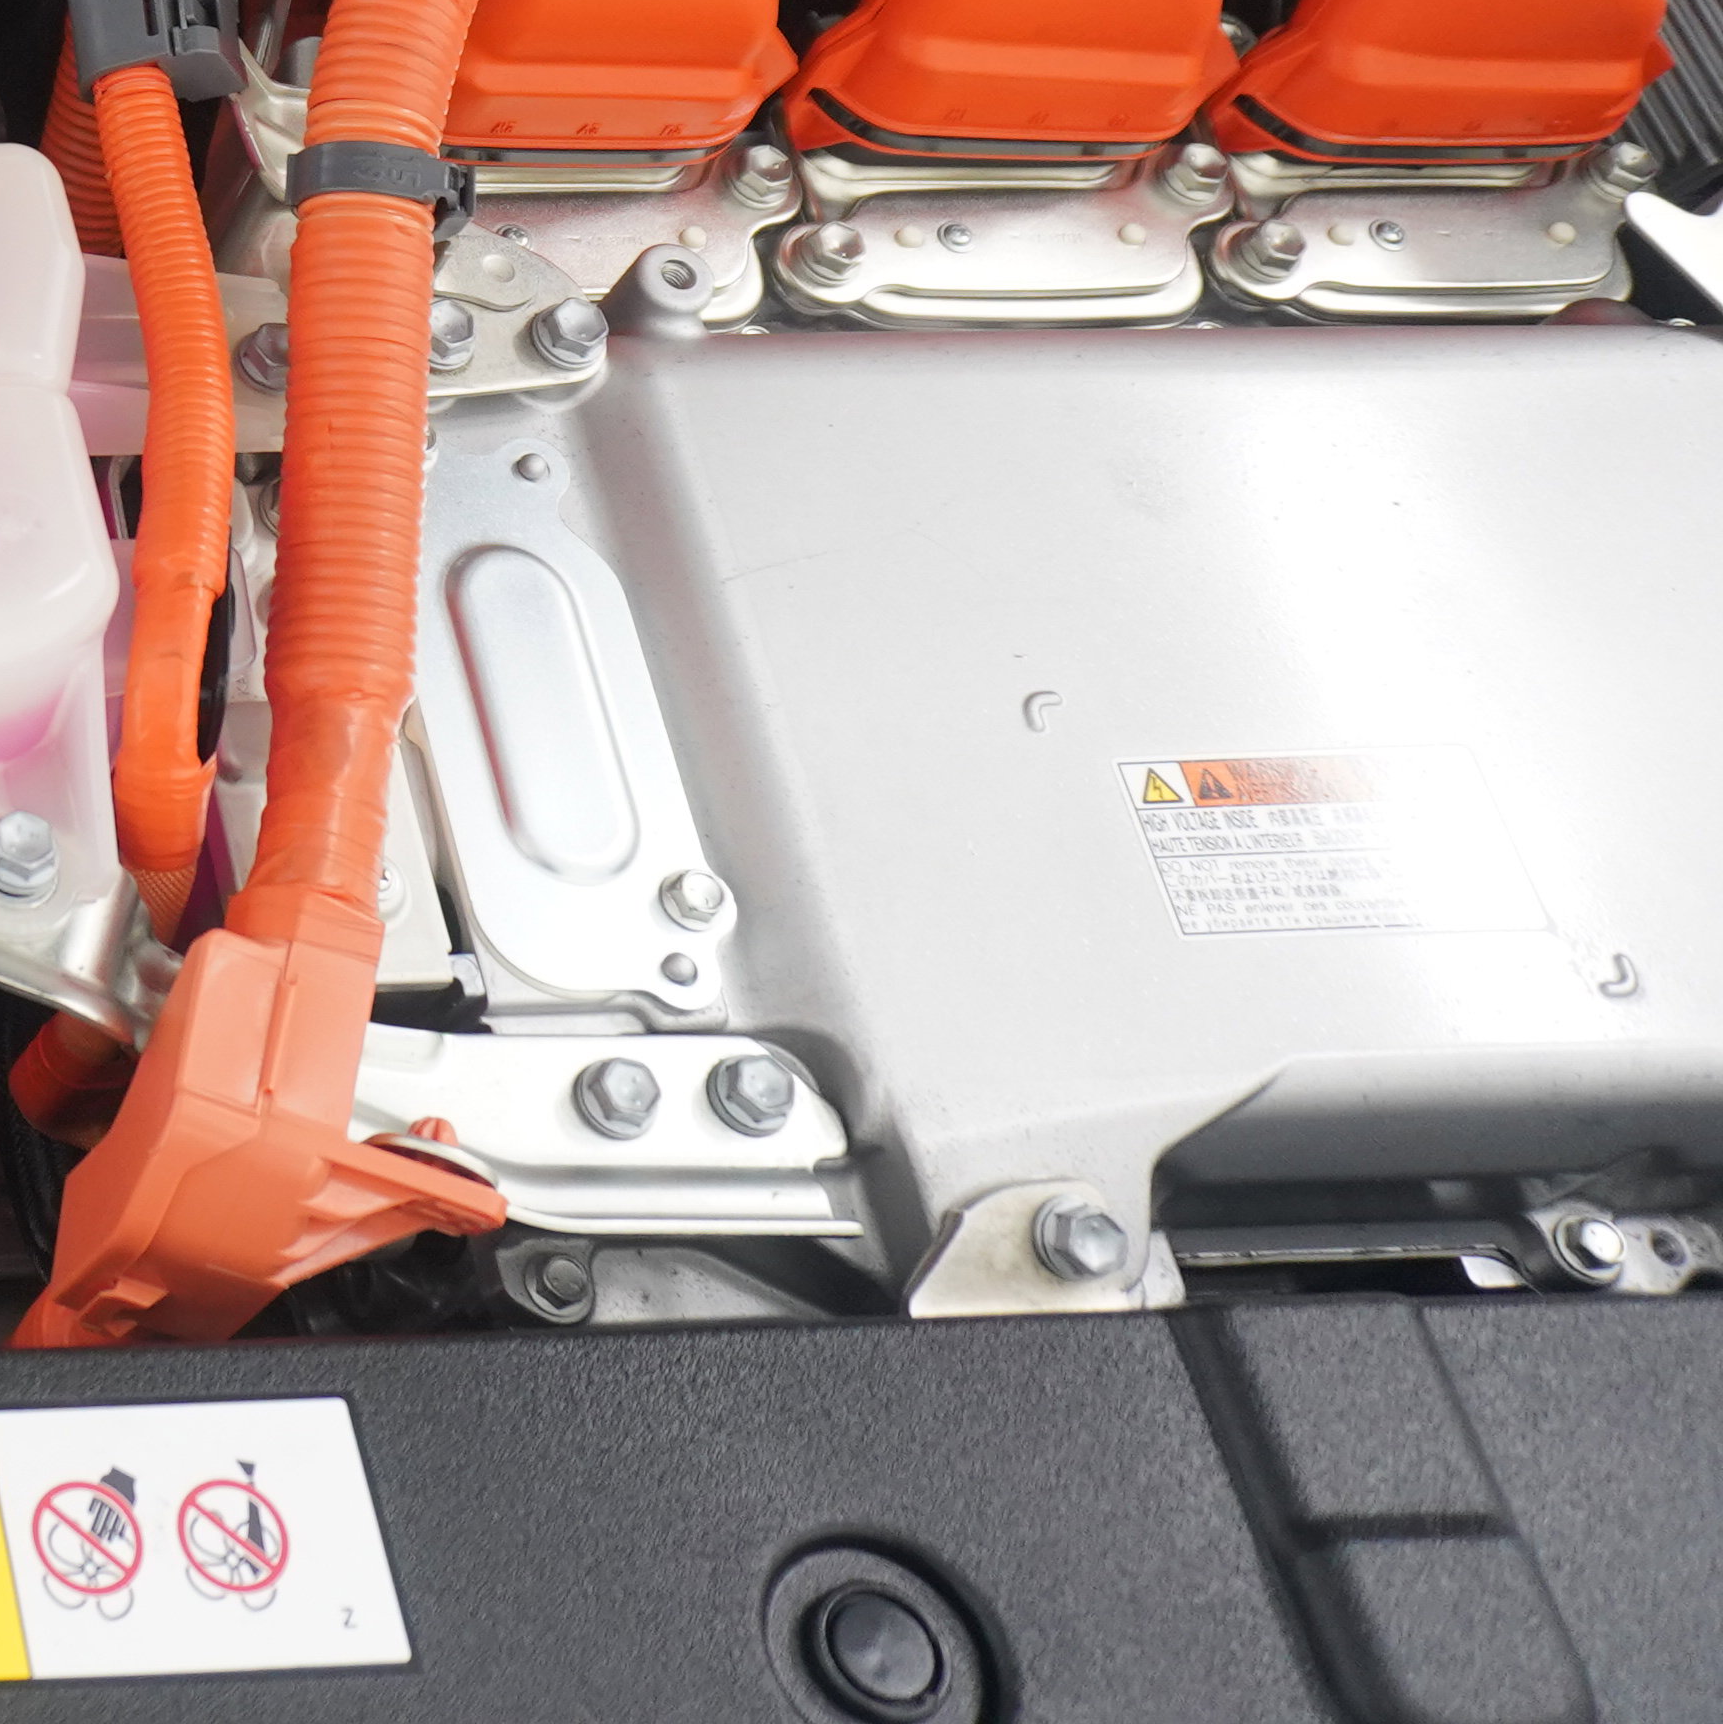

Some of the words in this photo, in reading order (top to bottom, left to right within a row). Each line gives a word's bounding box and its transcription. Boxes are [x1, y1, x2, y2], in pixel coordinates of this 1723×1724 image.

[1171, 811, 1222, 831] VOLTAGE
[1220, 808, 1259, 829] INSIDE
[1148, 836, 1188, 852] HAUTE
[1186, 834, 1233, 851] TENSION
[1158, 861, 1183, 873] DO
[1188, 858, 1221, 872] NOT
[1227, 858, 1278, 870] remove
[1283, 855, 1322, 867] these
[1175, 904, 1198, 916] NE
[1205, 901, 1237, 915] PAS
